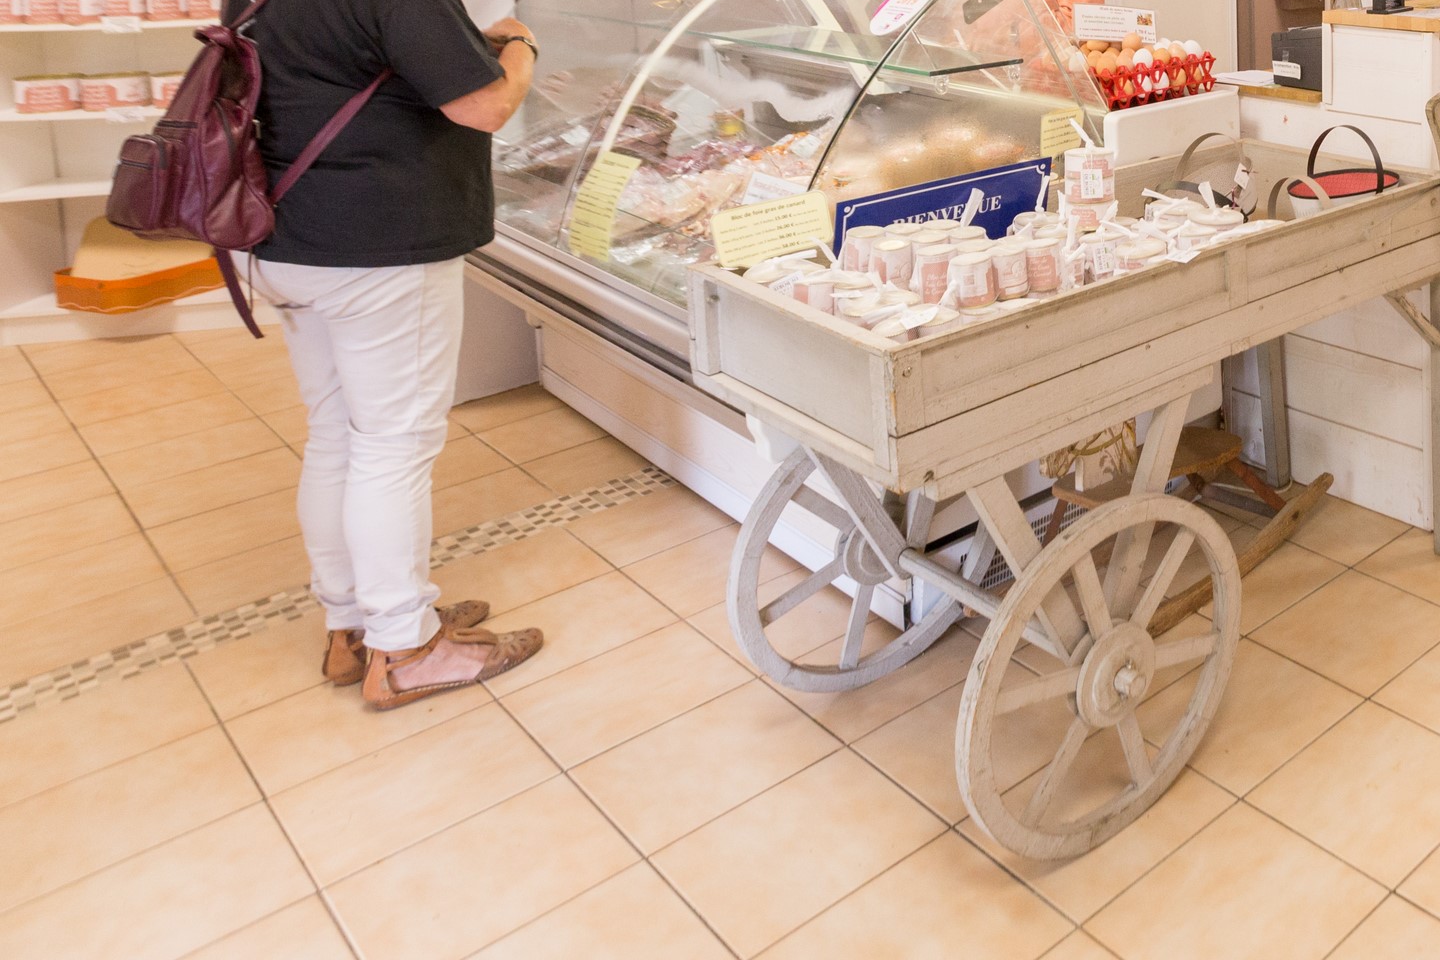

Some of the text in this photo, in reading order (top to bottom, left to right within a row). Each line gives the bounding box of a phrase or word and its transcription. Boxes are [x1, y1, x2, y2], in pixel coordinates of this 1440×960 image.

[752, 208, 764, 217] foie
[764, 205, 777, 214] gras
[786, 199, 806, 208] canard
[892, 195, 1002, 224] IENVEUE
